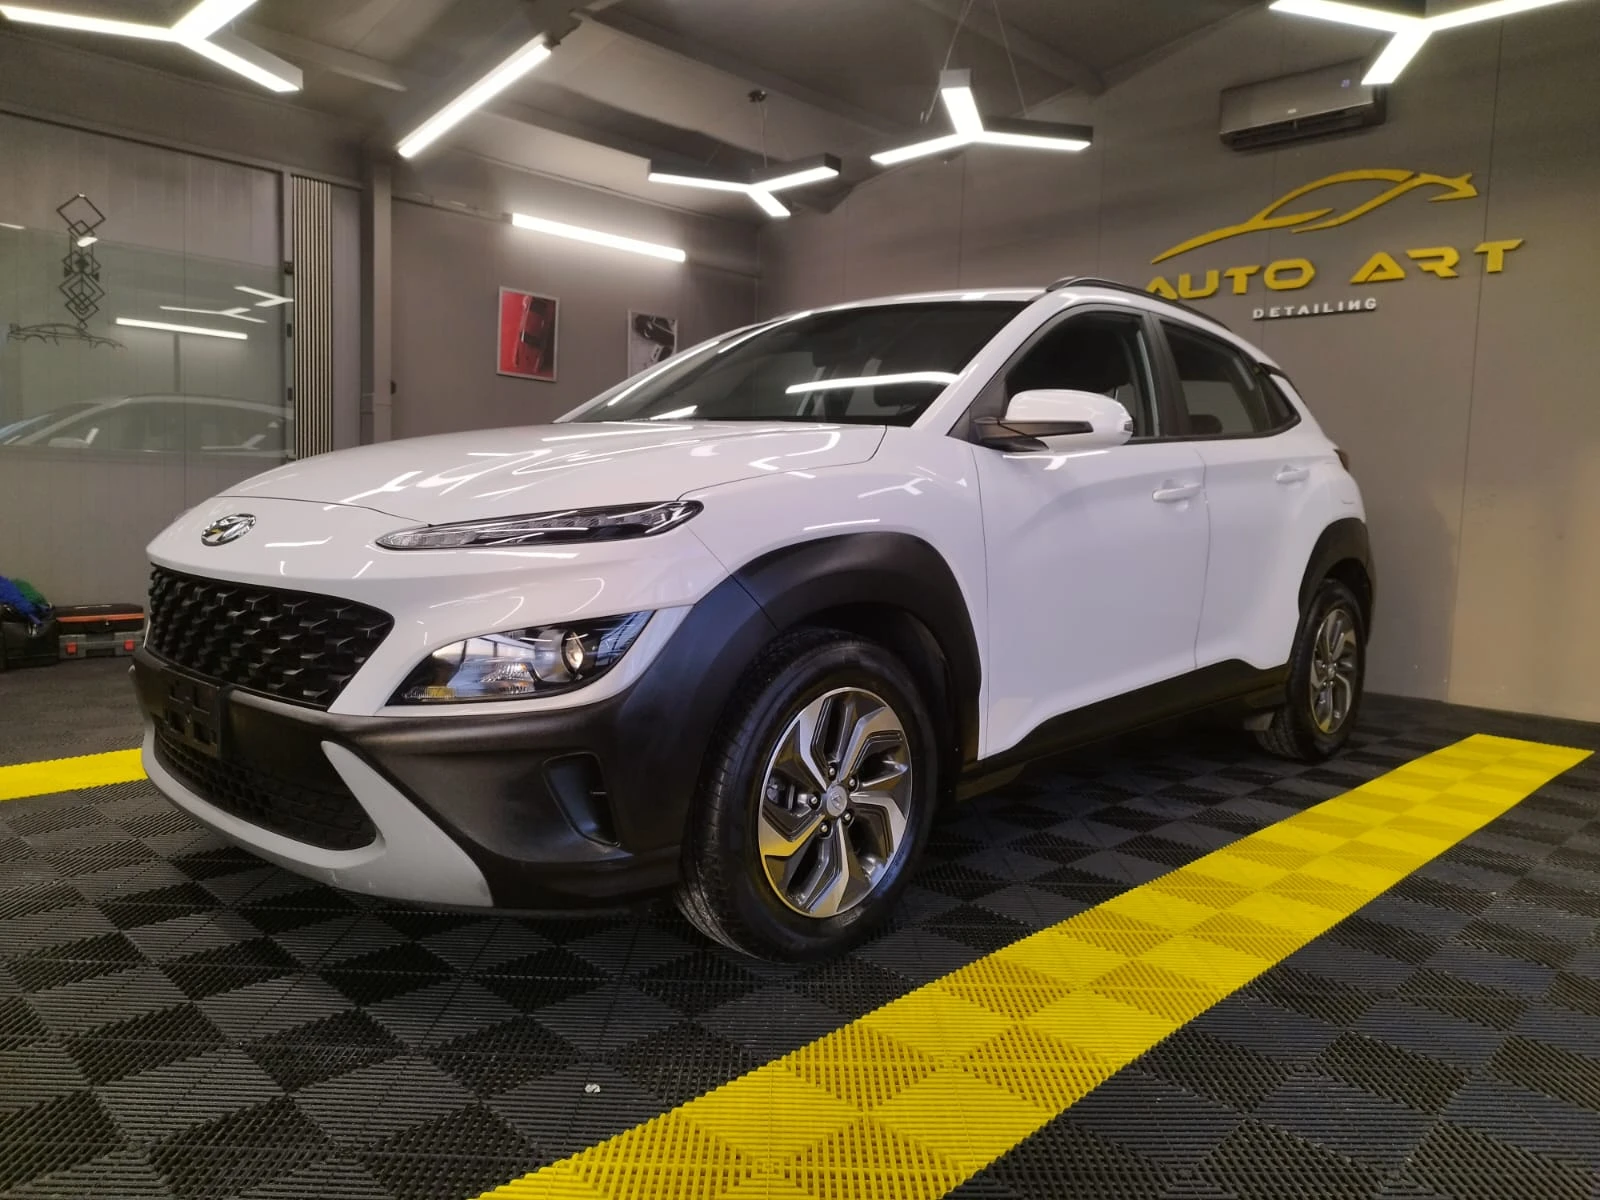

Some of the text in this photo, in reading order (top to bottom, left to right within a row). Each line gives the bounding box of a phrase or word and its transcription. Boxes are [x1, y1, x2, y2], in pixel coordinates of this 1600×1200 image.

[1146, 239, 1524, 299] AUTO ART
[1252, 297, 1377, 320] DETAILING
